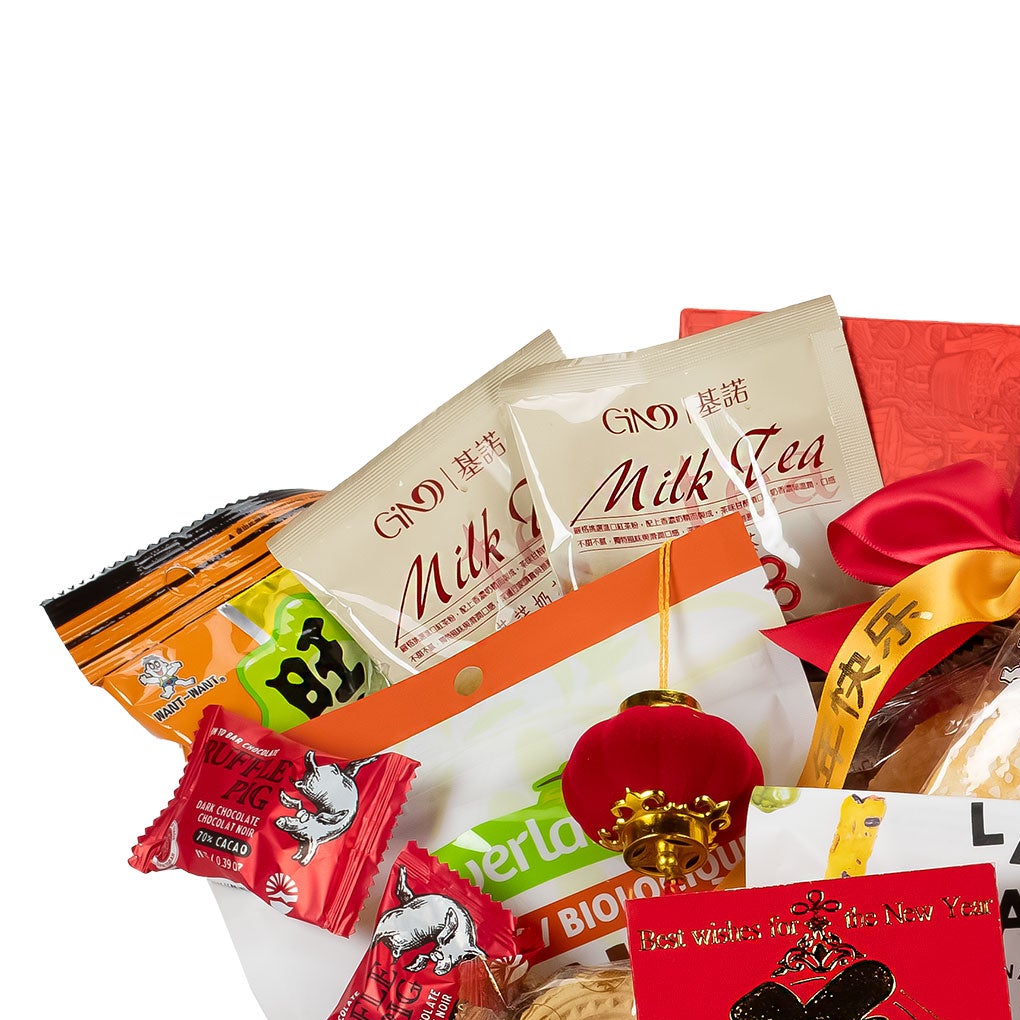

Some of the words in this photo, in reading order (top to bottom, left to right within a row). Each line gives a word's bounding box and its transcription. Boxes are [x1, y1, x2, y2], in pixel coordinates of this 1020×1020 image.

[570, 448, 713, 527] Milk
[731, 423, 825, 488] Tea
[395, 507, 505, 648] Milk
[225, 732, 244, 745] BAR
[203, 739, 293, 784] RUFFLE
[221, 780, 273, 811] PIG
[195, 800, 215, 812] DARK
[216, 805, 261, 827] CHOCOLATE
[197, 813, 236, 833] CHOCOLAT
[235, 824, 255, 838] NOIR
[195, 831, 213, 843] 70%
[215, 837, 248, 855] CACAO
[638, 929, 687, 952] Best
[691, 921, 763, 946] wishes
[769, 916, 800, 937] for
[844, 906, 878, 929] the
[882, 902, 934, 925] New
[940, 896, 994, 918] Year
[435, 994, 453, 1018] NOIR
